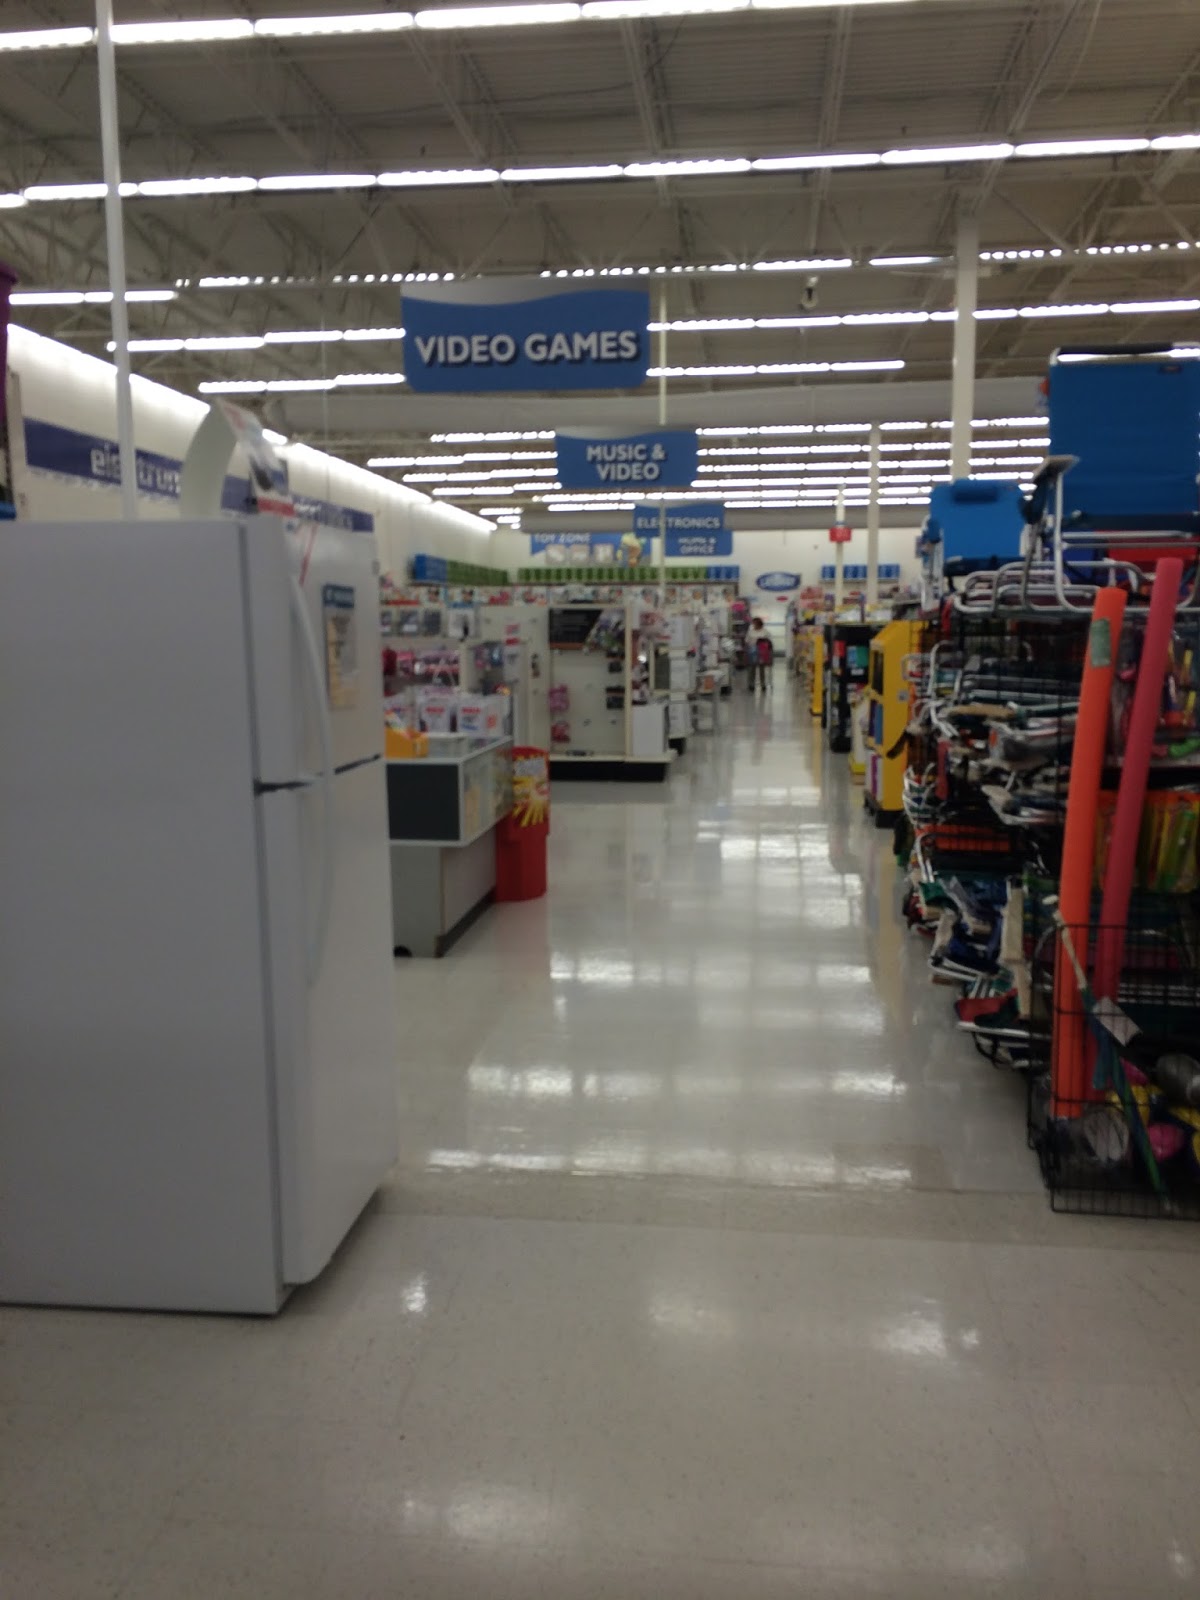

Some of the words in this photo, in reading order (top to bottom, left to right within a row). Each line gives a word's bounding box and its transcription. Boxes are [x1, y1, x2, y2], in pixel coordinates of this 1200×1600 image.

[414, 334, 516, 364] VIDEO
[523, 330, 638, 362] GAMES
[586, 443, 648, 461] MUSIC
[651, 442, 666, 460] &
[596, 462, 660, 480] VIDEO
[681, 545, 715, 555] OFFICE
